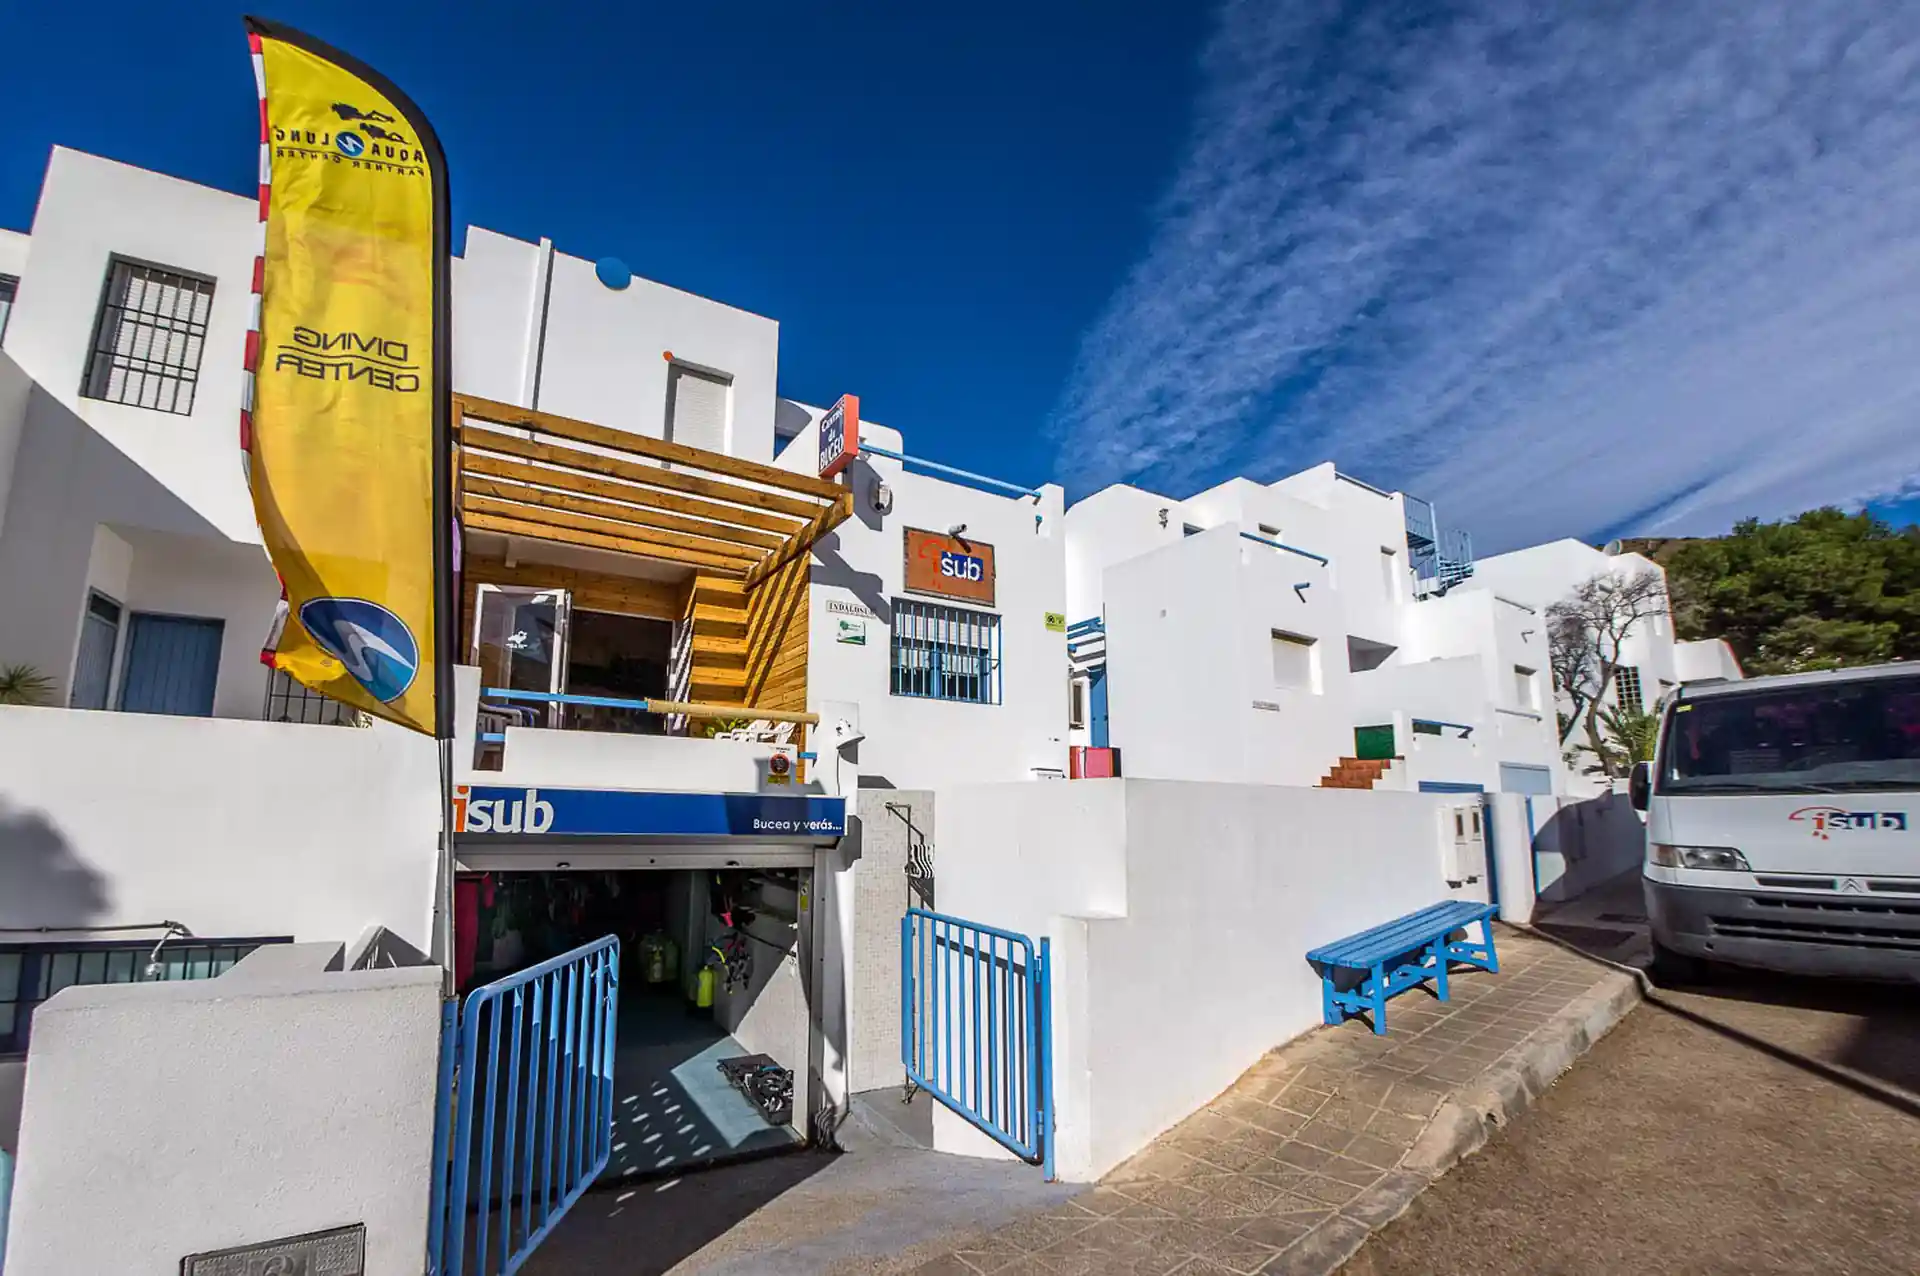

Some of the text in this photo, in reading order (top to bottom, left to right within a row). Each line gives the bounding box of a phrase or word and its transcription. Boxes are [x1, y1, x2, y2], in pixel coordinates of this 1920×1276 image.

[820, 434, 844, 470] BUCEO
[452, 786, 554, 834] isub
[753, 818, 842, 832] Bucea y verás...
